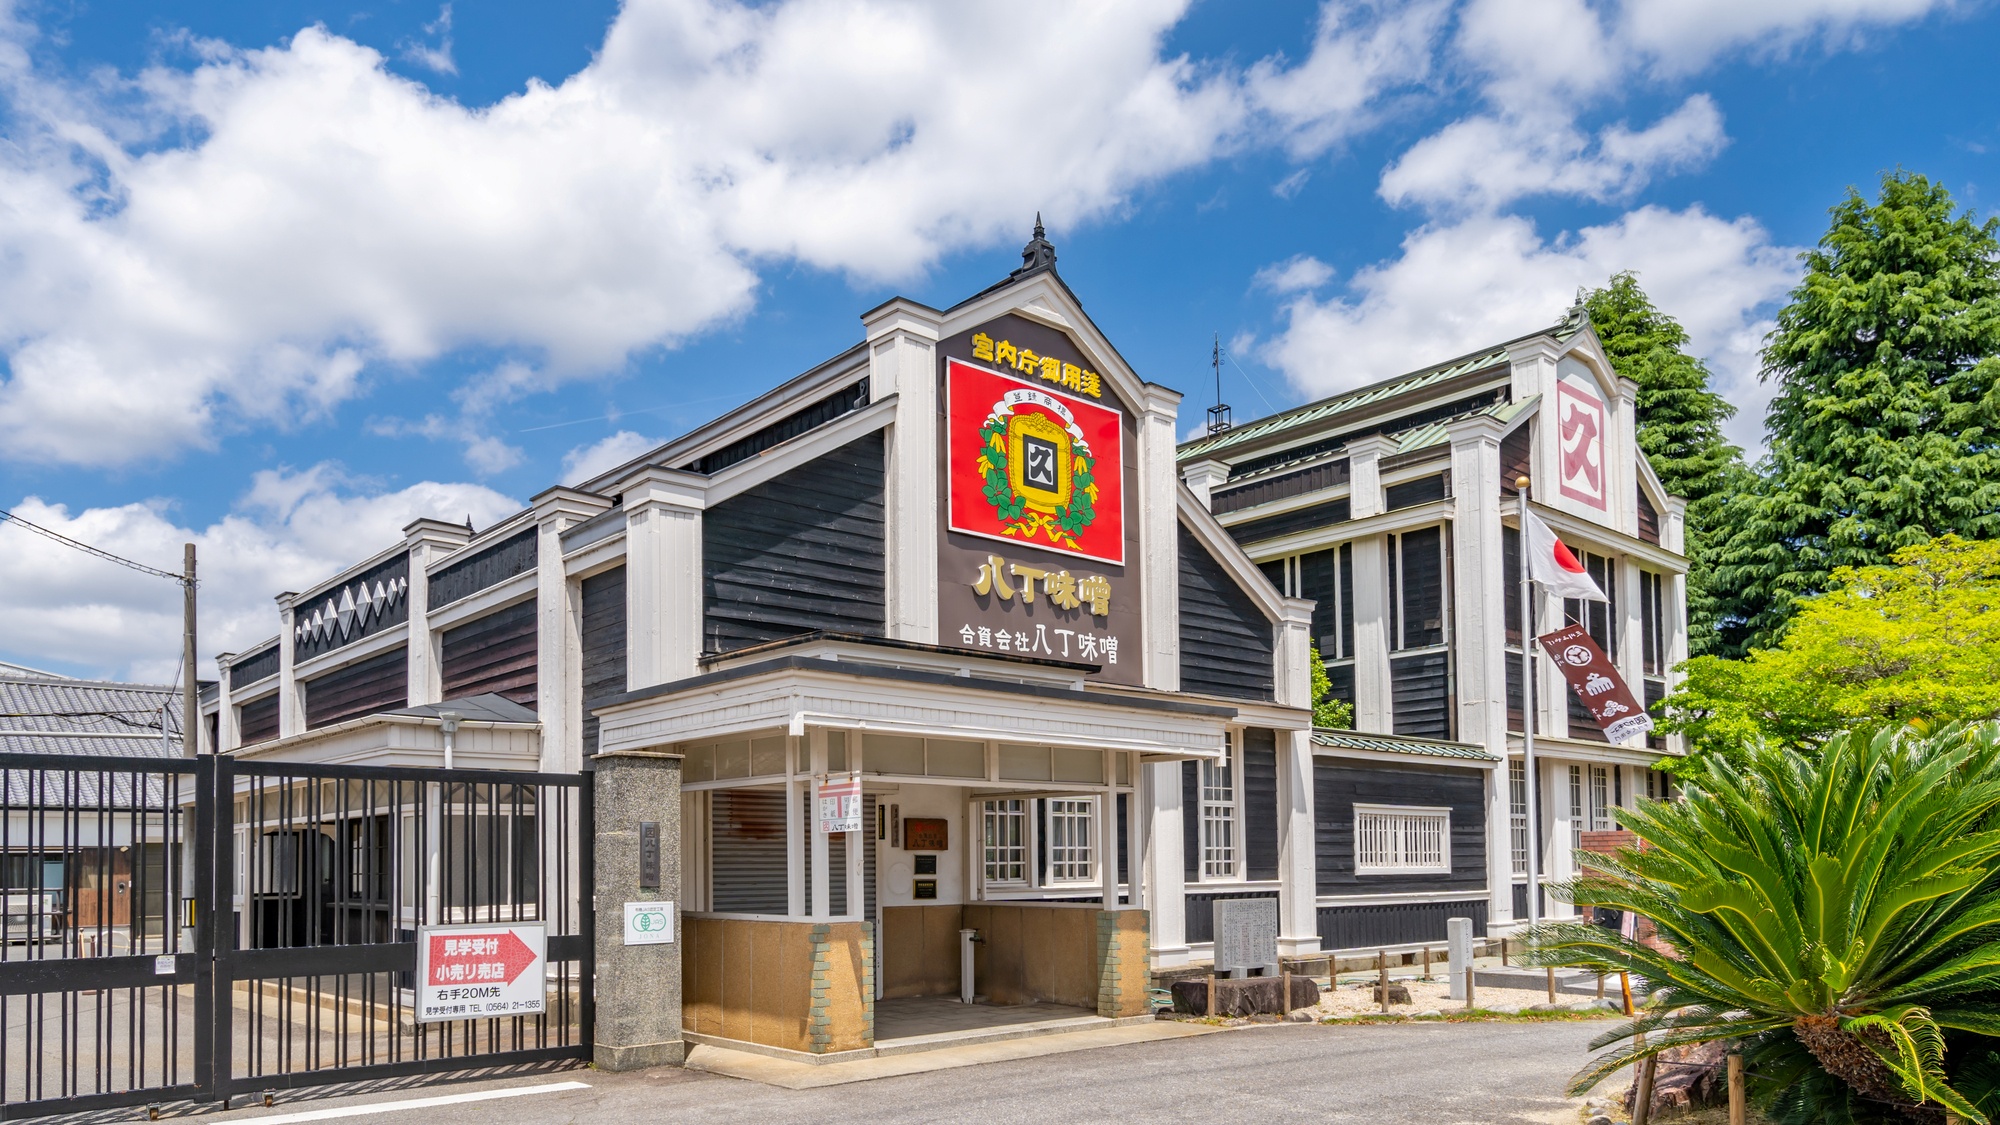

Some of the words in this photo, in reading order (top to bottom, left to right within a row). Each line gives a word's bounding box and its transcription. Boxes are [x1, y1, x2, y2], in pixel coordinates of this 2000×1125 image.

[972, 332, 1103, 399] 宮内庁御用達
[1562, 402, 1598, 492] 久
[1030, 446, 1052, 483] 久
[972, 554, 1112, 617] 八丁味噌
[444, 938, 499, 957] 見学受付
[436, 962, 505, 982] 小売り売店
[437, 986, 501, 1001] 右手20M先
[425, 1004, 466, 1016] 見学受付専用
[469, 1004, 482, 1013] TEL
